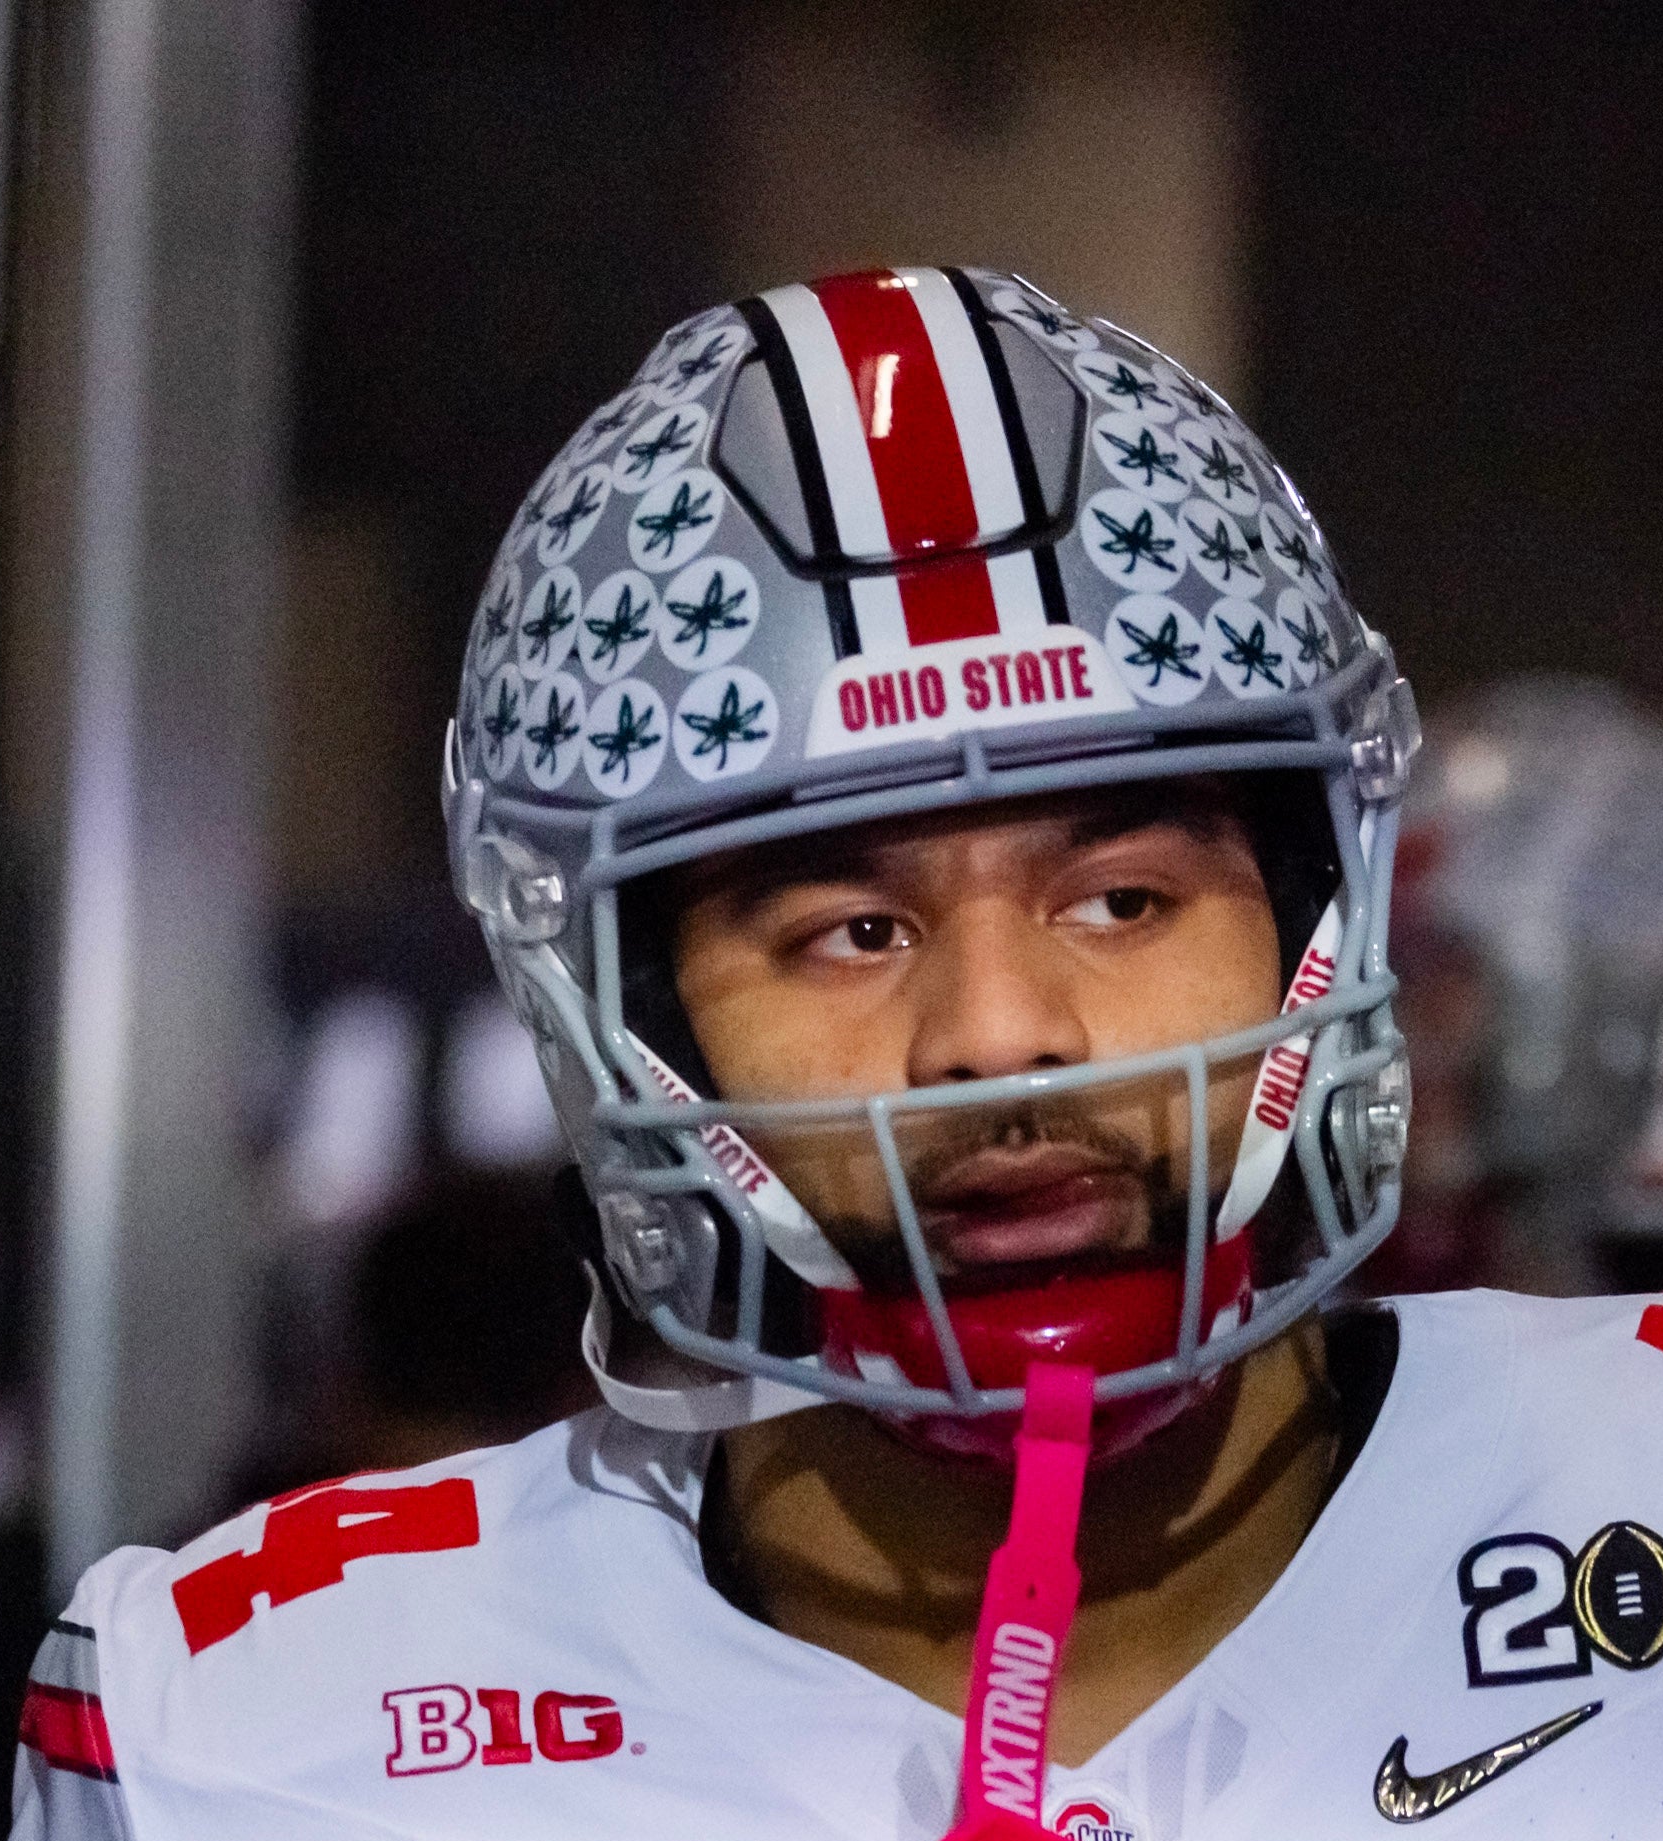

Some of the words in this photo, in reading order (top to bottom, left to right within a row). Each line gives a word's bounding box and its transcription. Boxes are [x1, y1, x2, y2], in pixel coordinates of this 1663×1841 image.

[838, 665, 947, 732] OHIO
[960, 644, 1094, 712] STATE
[1254, 1046, 1311, 1131] OHIO
[704, 1125, 768, 1193] TATE
[980, 1622, 1055, 1820] NXTRND
